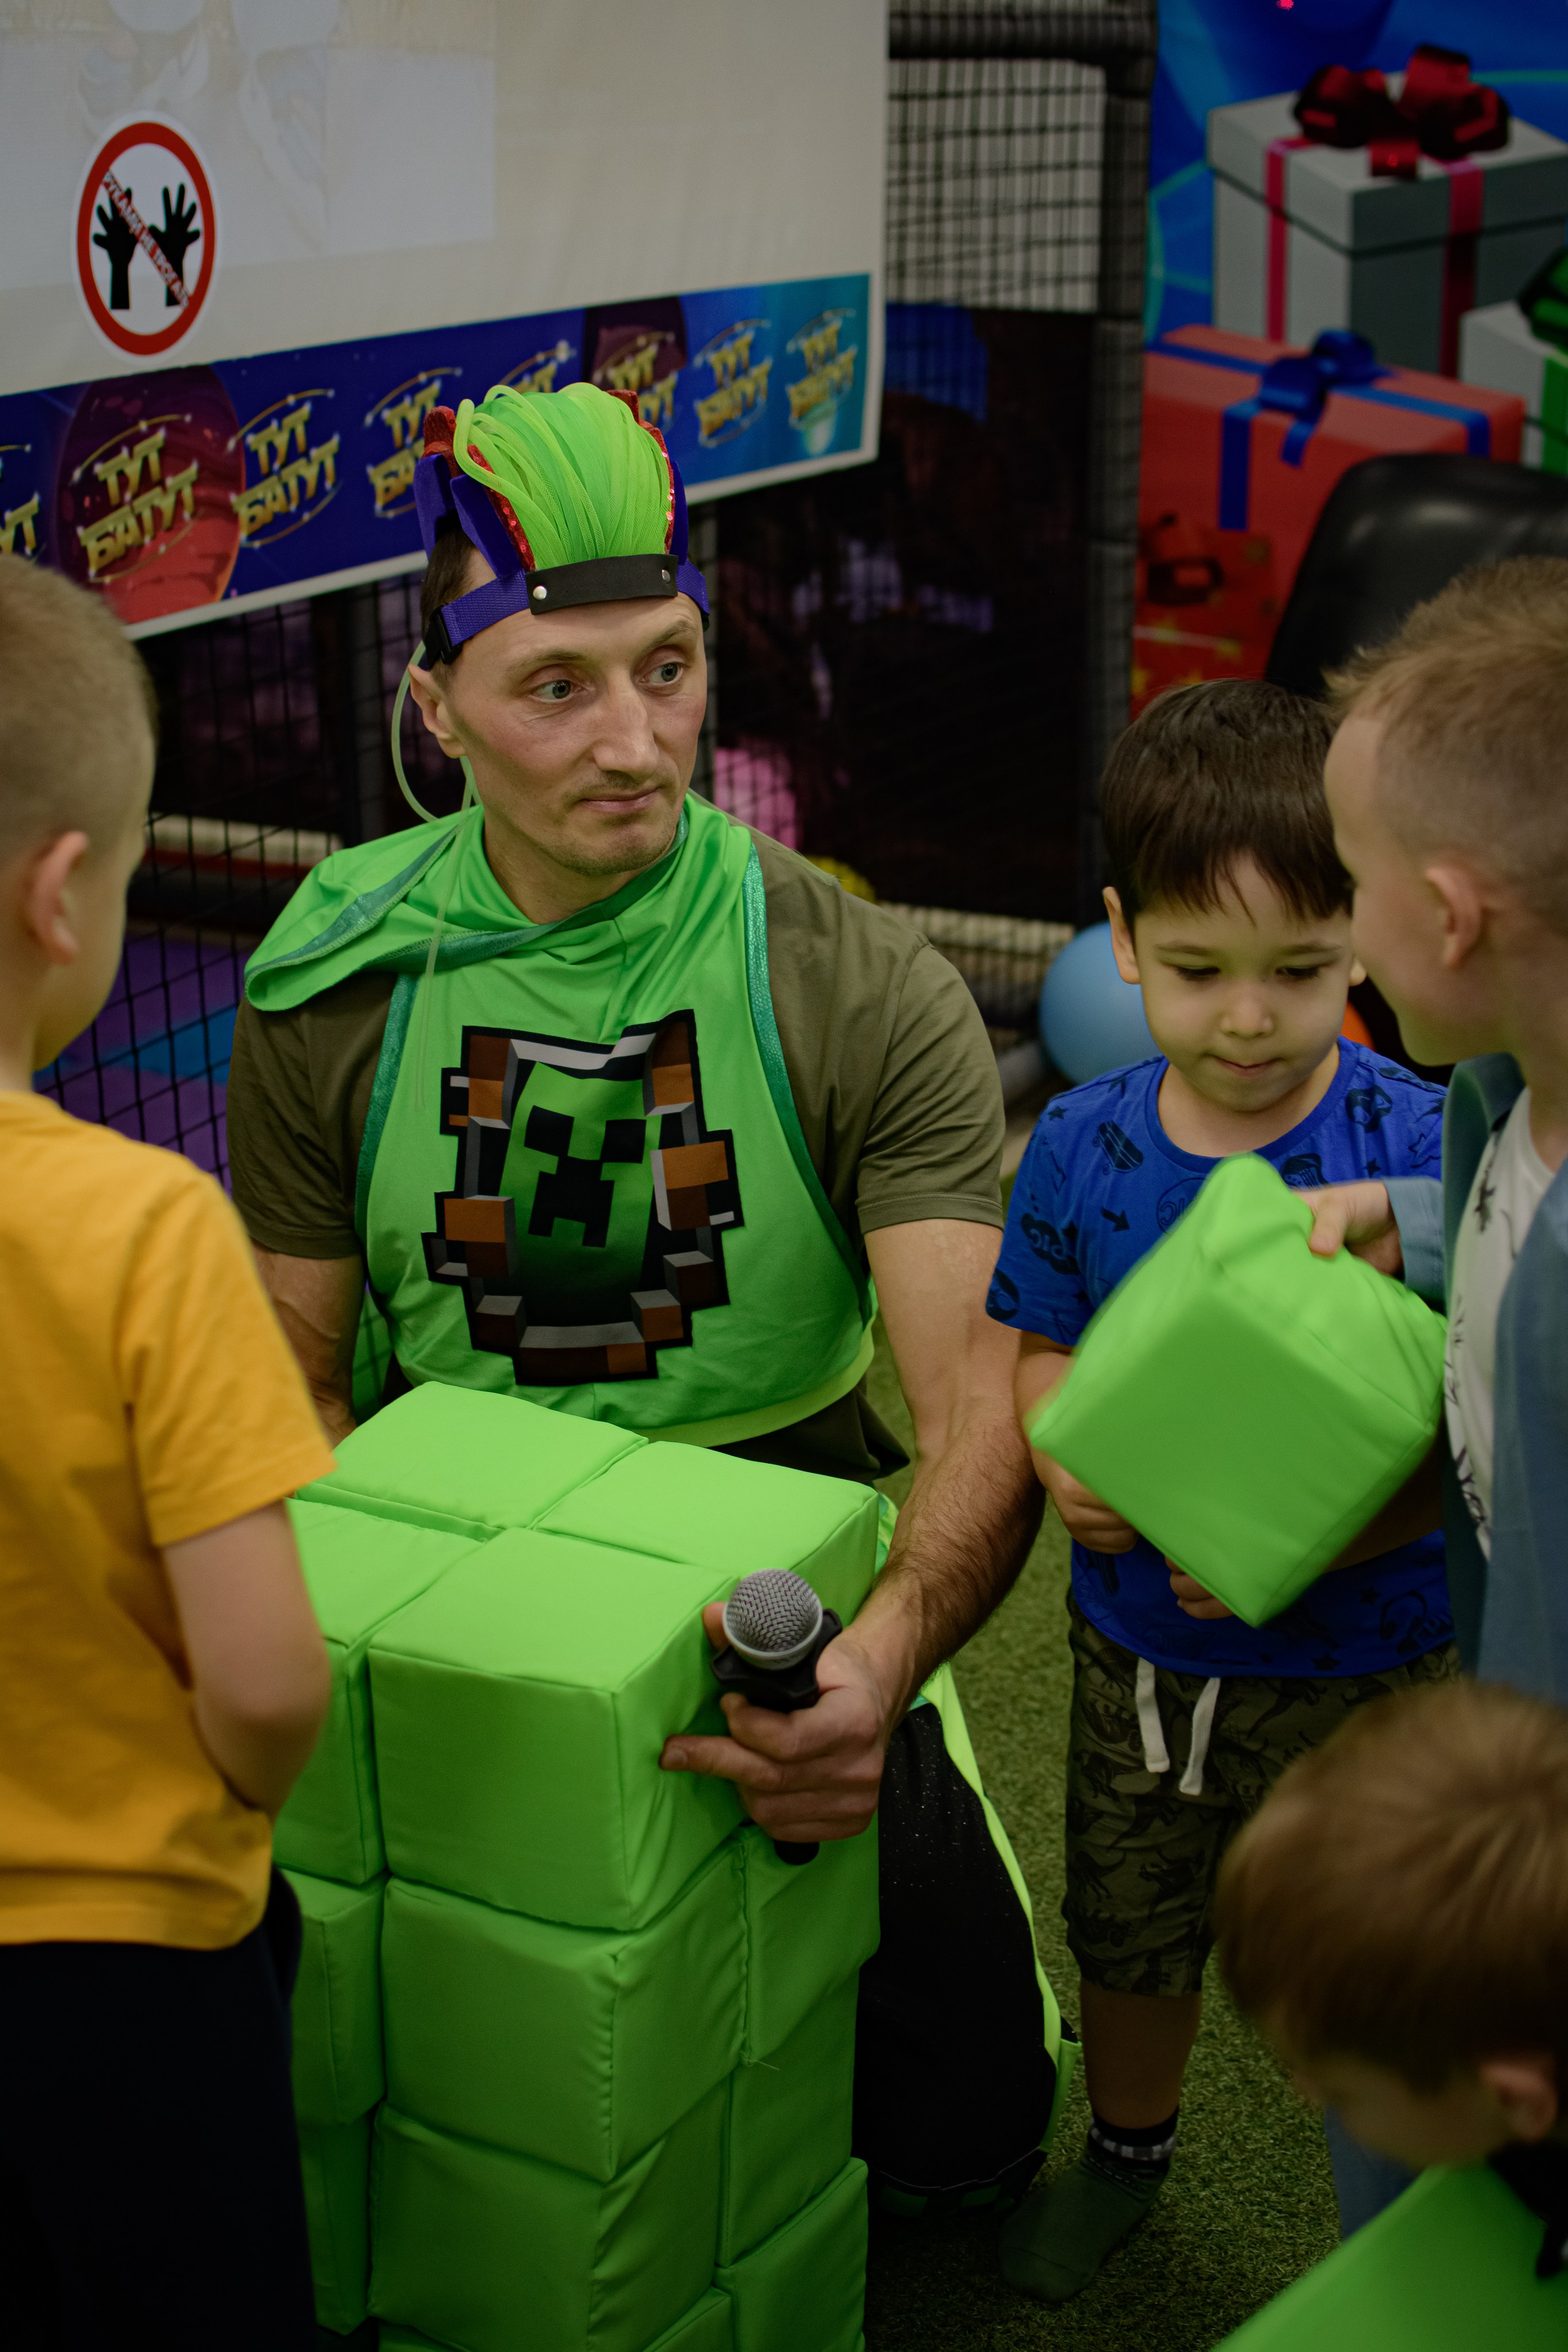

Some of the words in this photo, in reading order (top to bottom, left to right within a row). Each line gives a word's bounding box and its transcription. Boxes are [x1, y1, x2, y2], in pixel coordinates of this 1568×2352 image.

[94, 427, 165, 507] ТУТ
[246, 401, 311, 475] ТУТ
[77, 460, 198, 576] БАТУТ
[230, 433, 340, 538] БАТУТ
